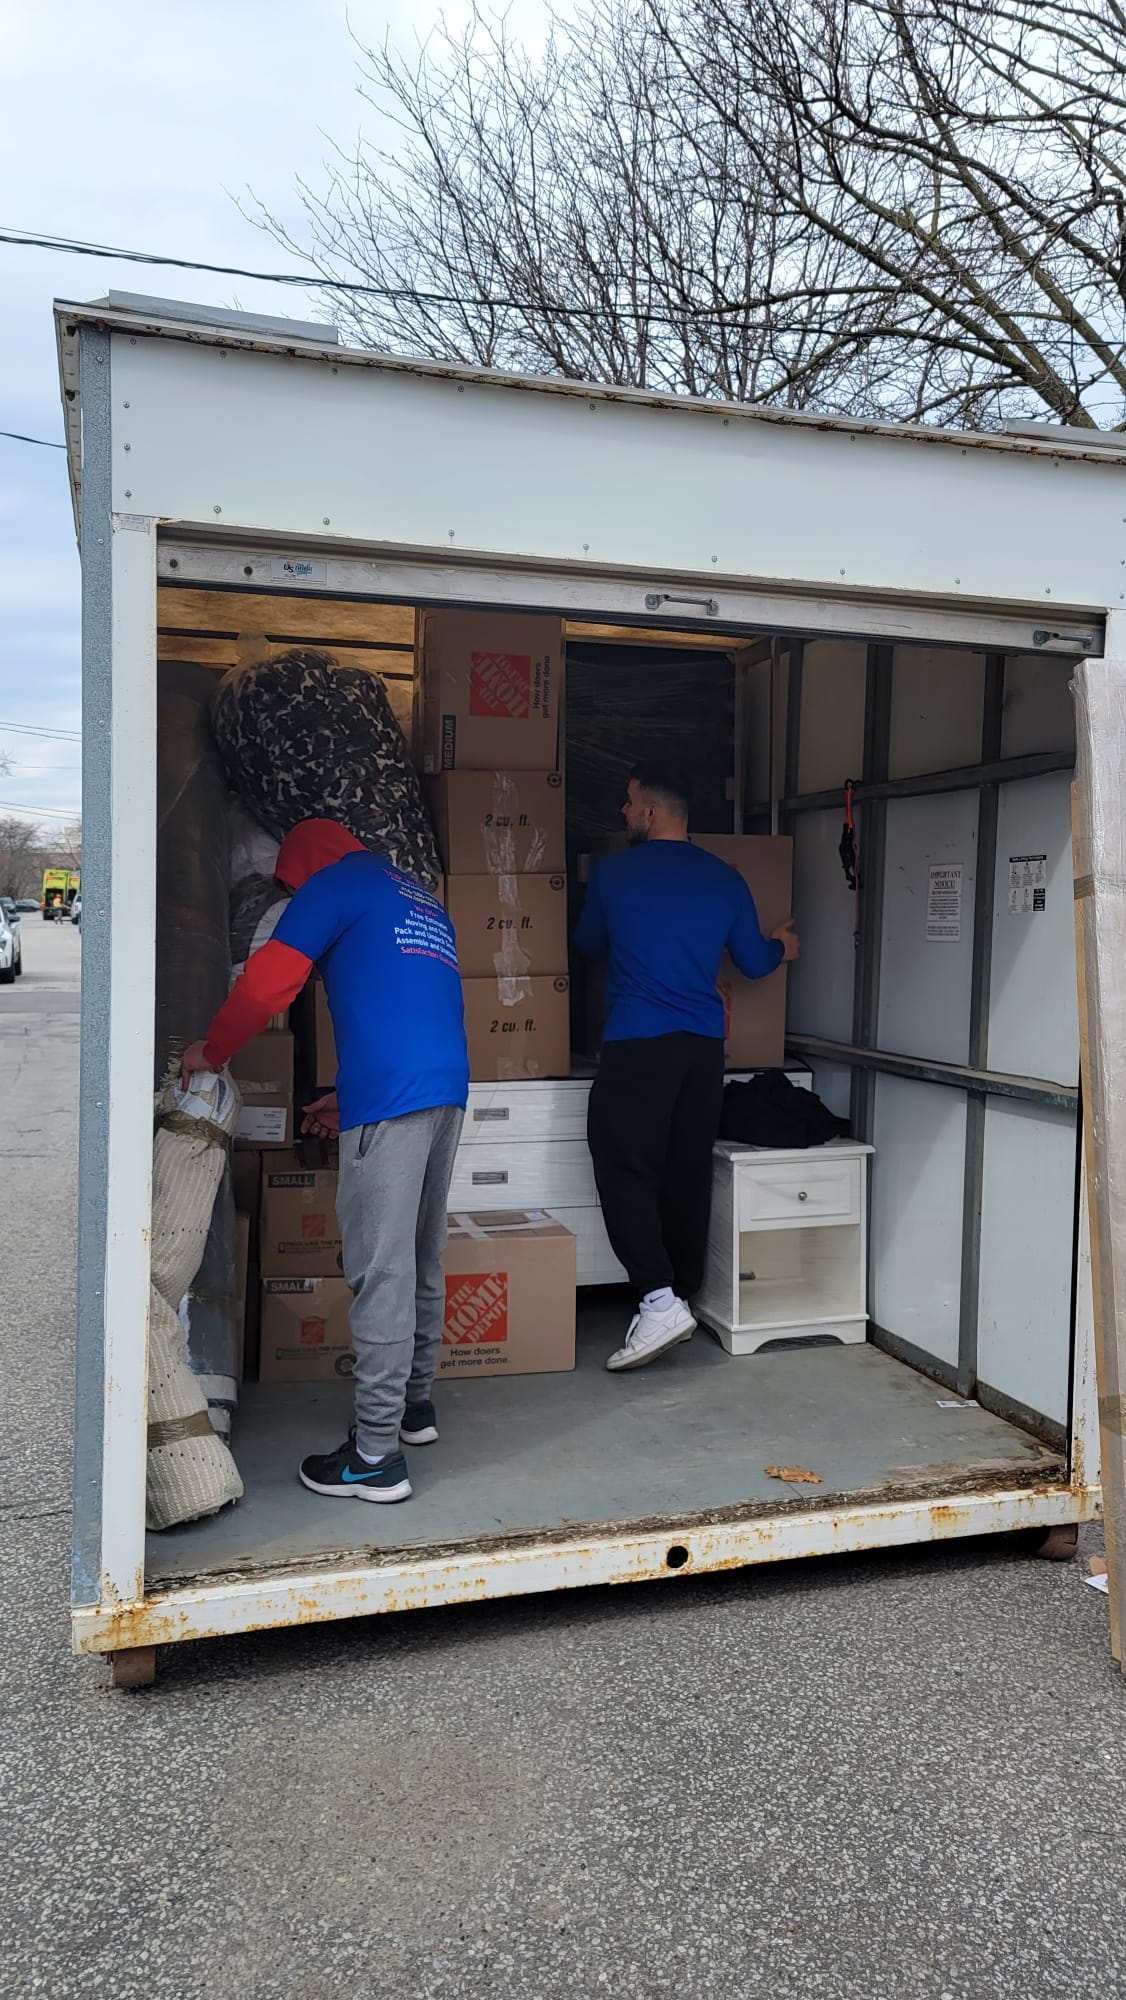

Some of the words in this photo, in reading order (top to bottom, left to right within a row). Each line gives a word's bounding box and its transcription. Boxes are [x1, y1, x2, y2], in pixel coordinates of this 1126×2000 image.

[533, 662, 541, 688] doers
[472, 654, 529, 717] HOME
[532, 689, 541, 709] How
[542, 704, 550, 718] get
[443, 719, 455, 769] MEDIUM
[485, 815, 492, 827] 2
[518, 814, 531, 827] ft.
[405, 918, 427, 931] Moving
[486, 917, 494, 930] 2
[521, 917, 533, 929] ft.
[394, 927, 413, 935] Pack
[414, 929, 426, 938] and
[396, 937, 429, 947] Assemble
[490, 1020, 498, 1033] 2
[524, 1019, 536, 1031] ft.
[272, 1175, 311, 1186] SMALL
[447, 1281, 472, 1310] THE
[442, 1273, 508, 1344] HOME
[466, 1299, 507, 1343] DEPOT
[450, 1348, 471, 1357] How
[474, 1347, 501, 1355] doers
[440, 1359, 456, 1369] get
[458, 1358, 482, 1367] more
